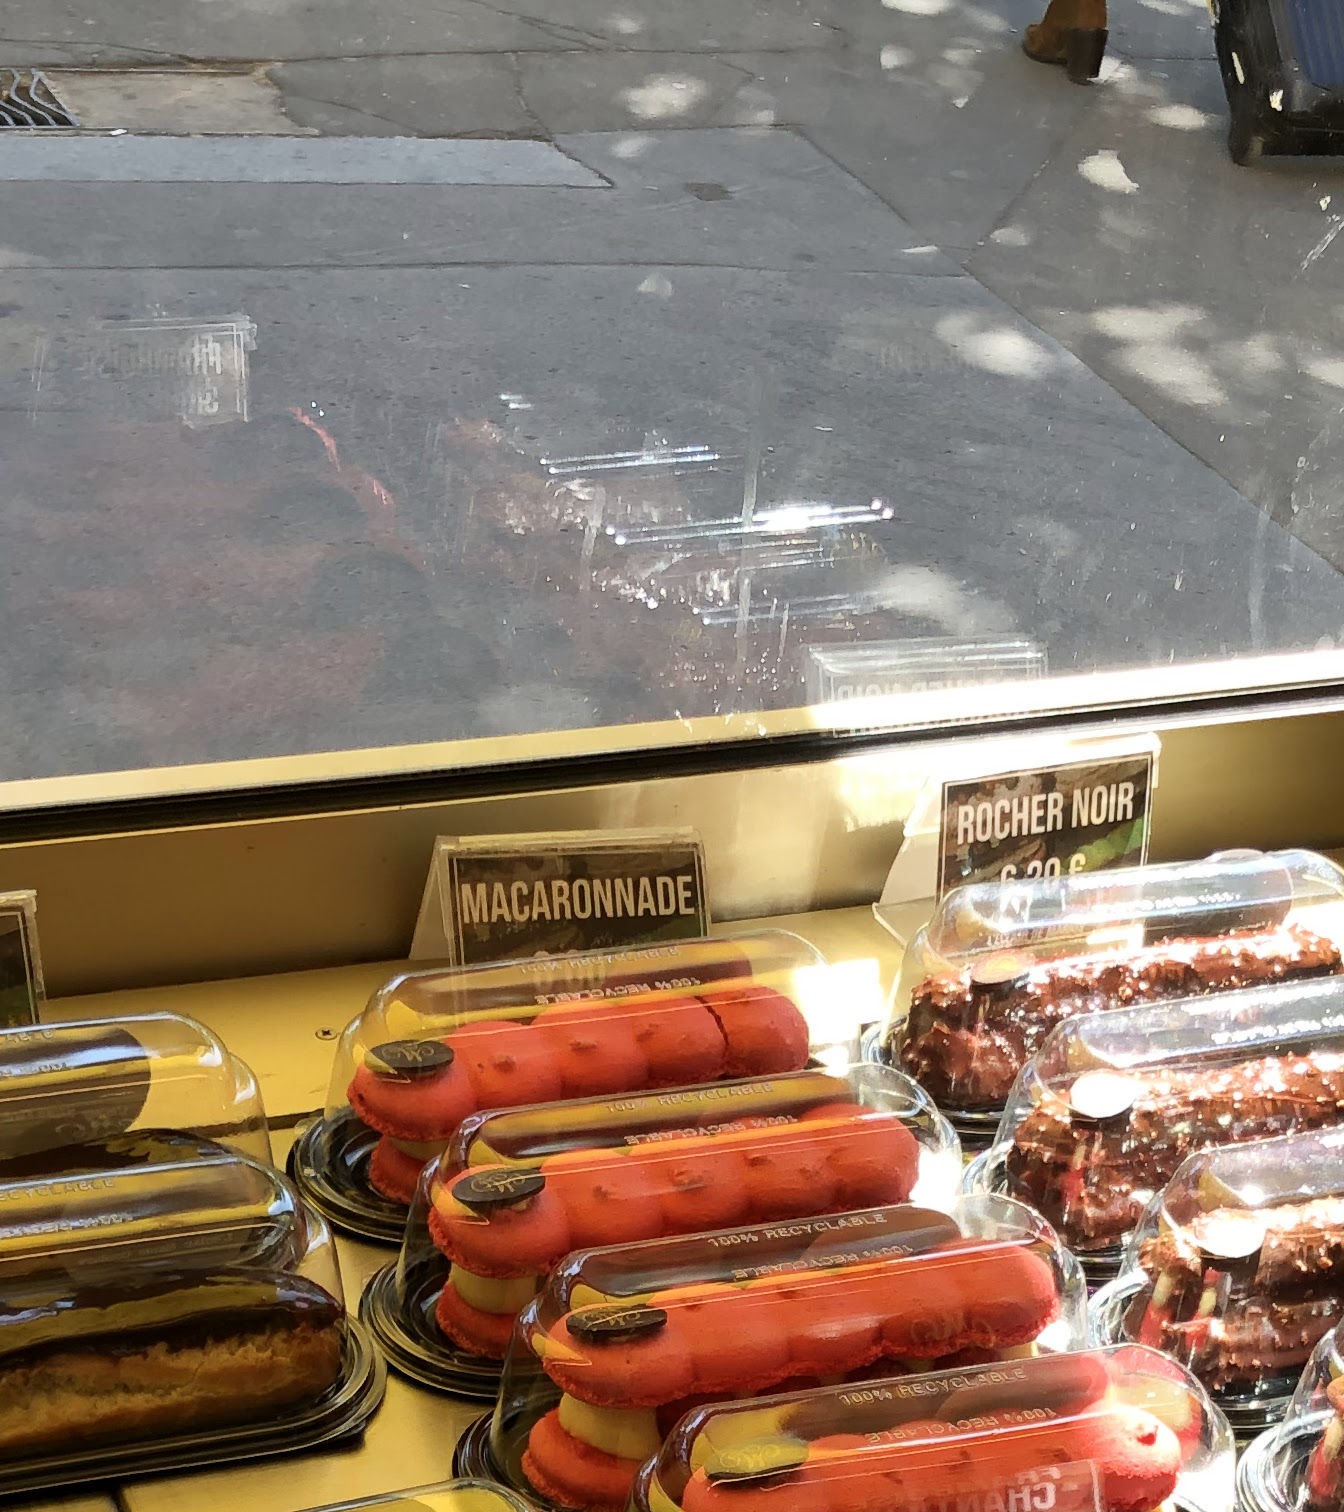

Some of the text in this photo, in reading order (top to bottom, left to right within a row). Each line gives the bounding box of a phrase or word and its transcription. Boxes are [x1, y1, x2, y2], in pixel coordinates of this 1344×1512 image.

[957, 781, 1135, 845] ROCHER NOIR
[460, 875, 696, 925] MACARONNADE
[708, 1213, 888, 1248] 100% RECYCLABLE
[840, 1365, 1028, 1406] 100% RECYCLABLE
